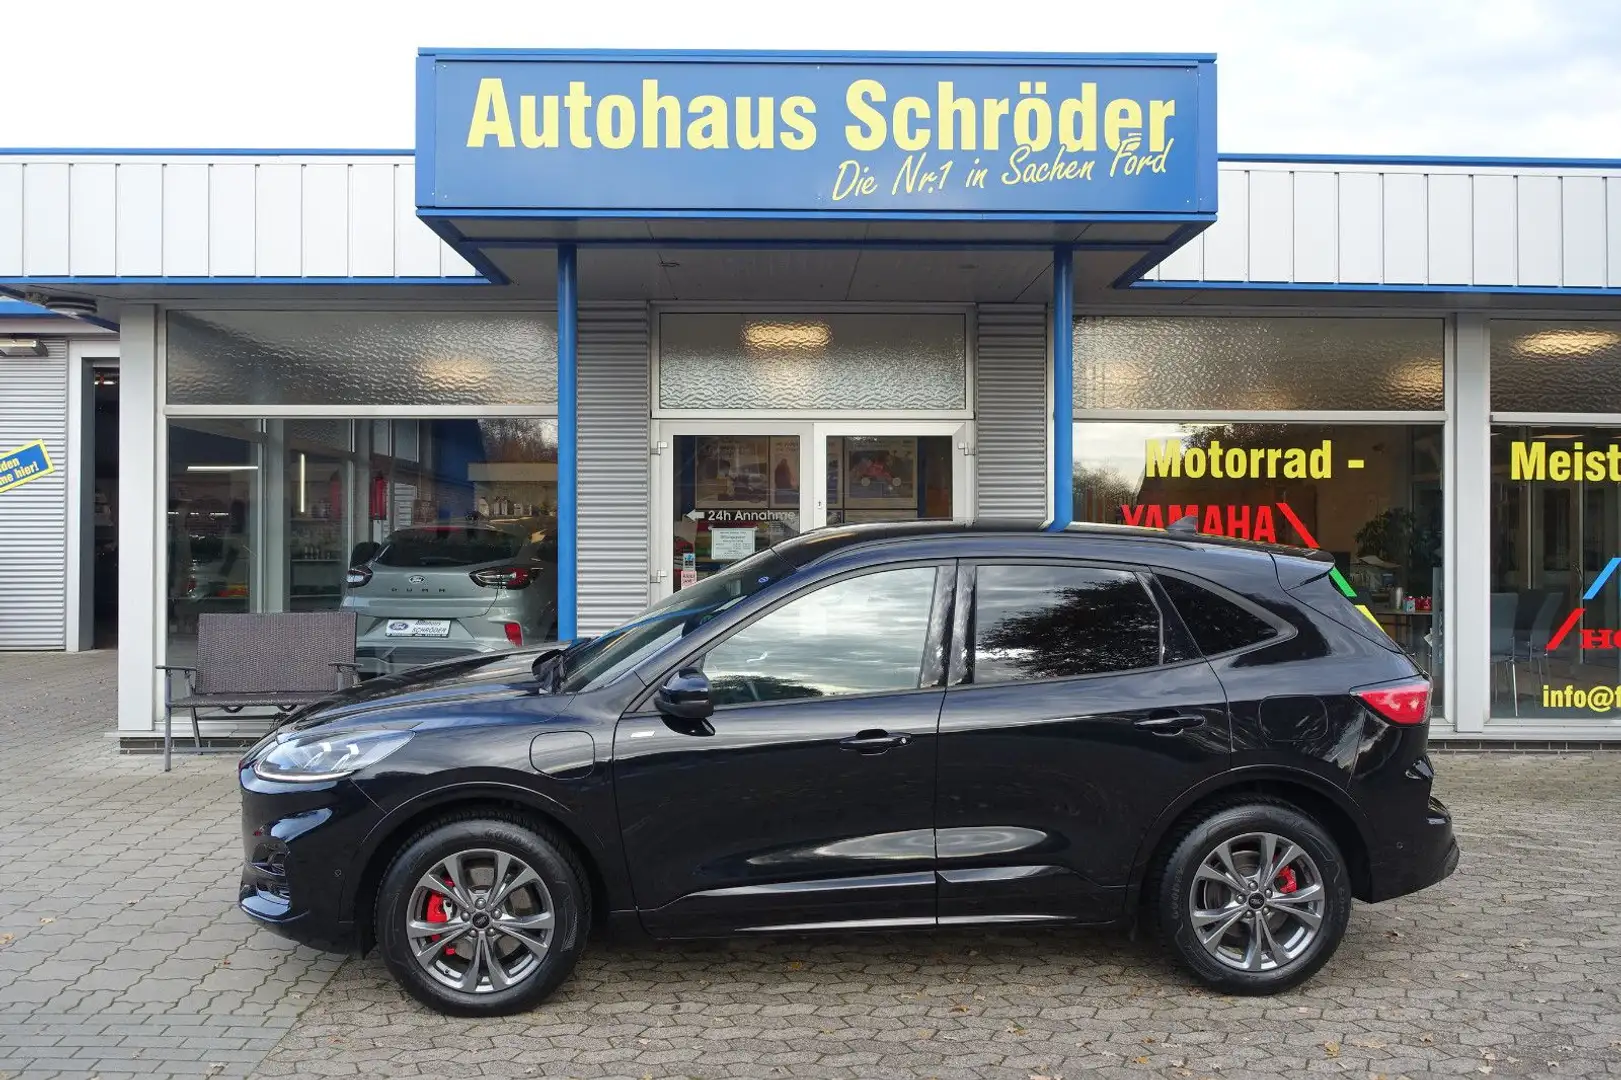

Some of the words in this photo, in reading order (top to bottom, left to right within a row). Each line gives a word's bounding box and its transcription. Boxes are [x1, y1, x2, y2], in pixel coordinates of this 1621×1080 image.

[466, 77, 817, 151] Autohaus
[845, 79, 1176, 153] Schröder
[832, 160, 877, 201] Die
[891, 153, 953, 196] Nr.1
[965, 158, 988, 189] in
[1002, 144, 1095, 185] Sachen
[1109, 131, 1175, 178] Ford
[0, 457, 20, 472] den
[13, 460, 40, 478] hier!
[1144, 439, 1332, 480] Motorrad
[1511, 441, 1621, 482] Meist
[708, 510, 731, 521] 24h
[735, 510, 796, 521] Annahme
[1543, 685, 1621, 712] info@f
